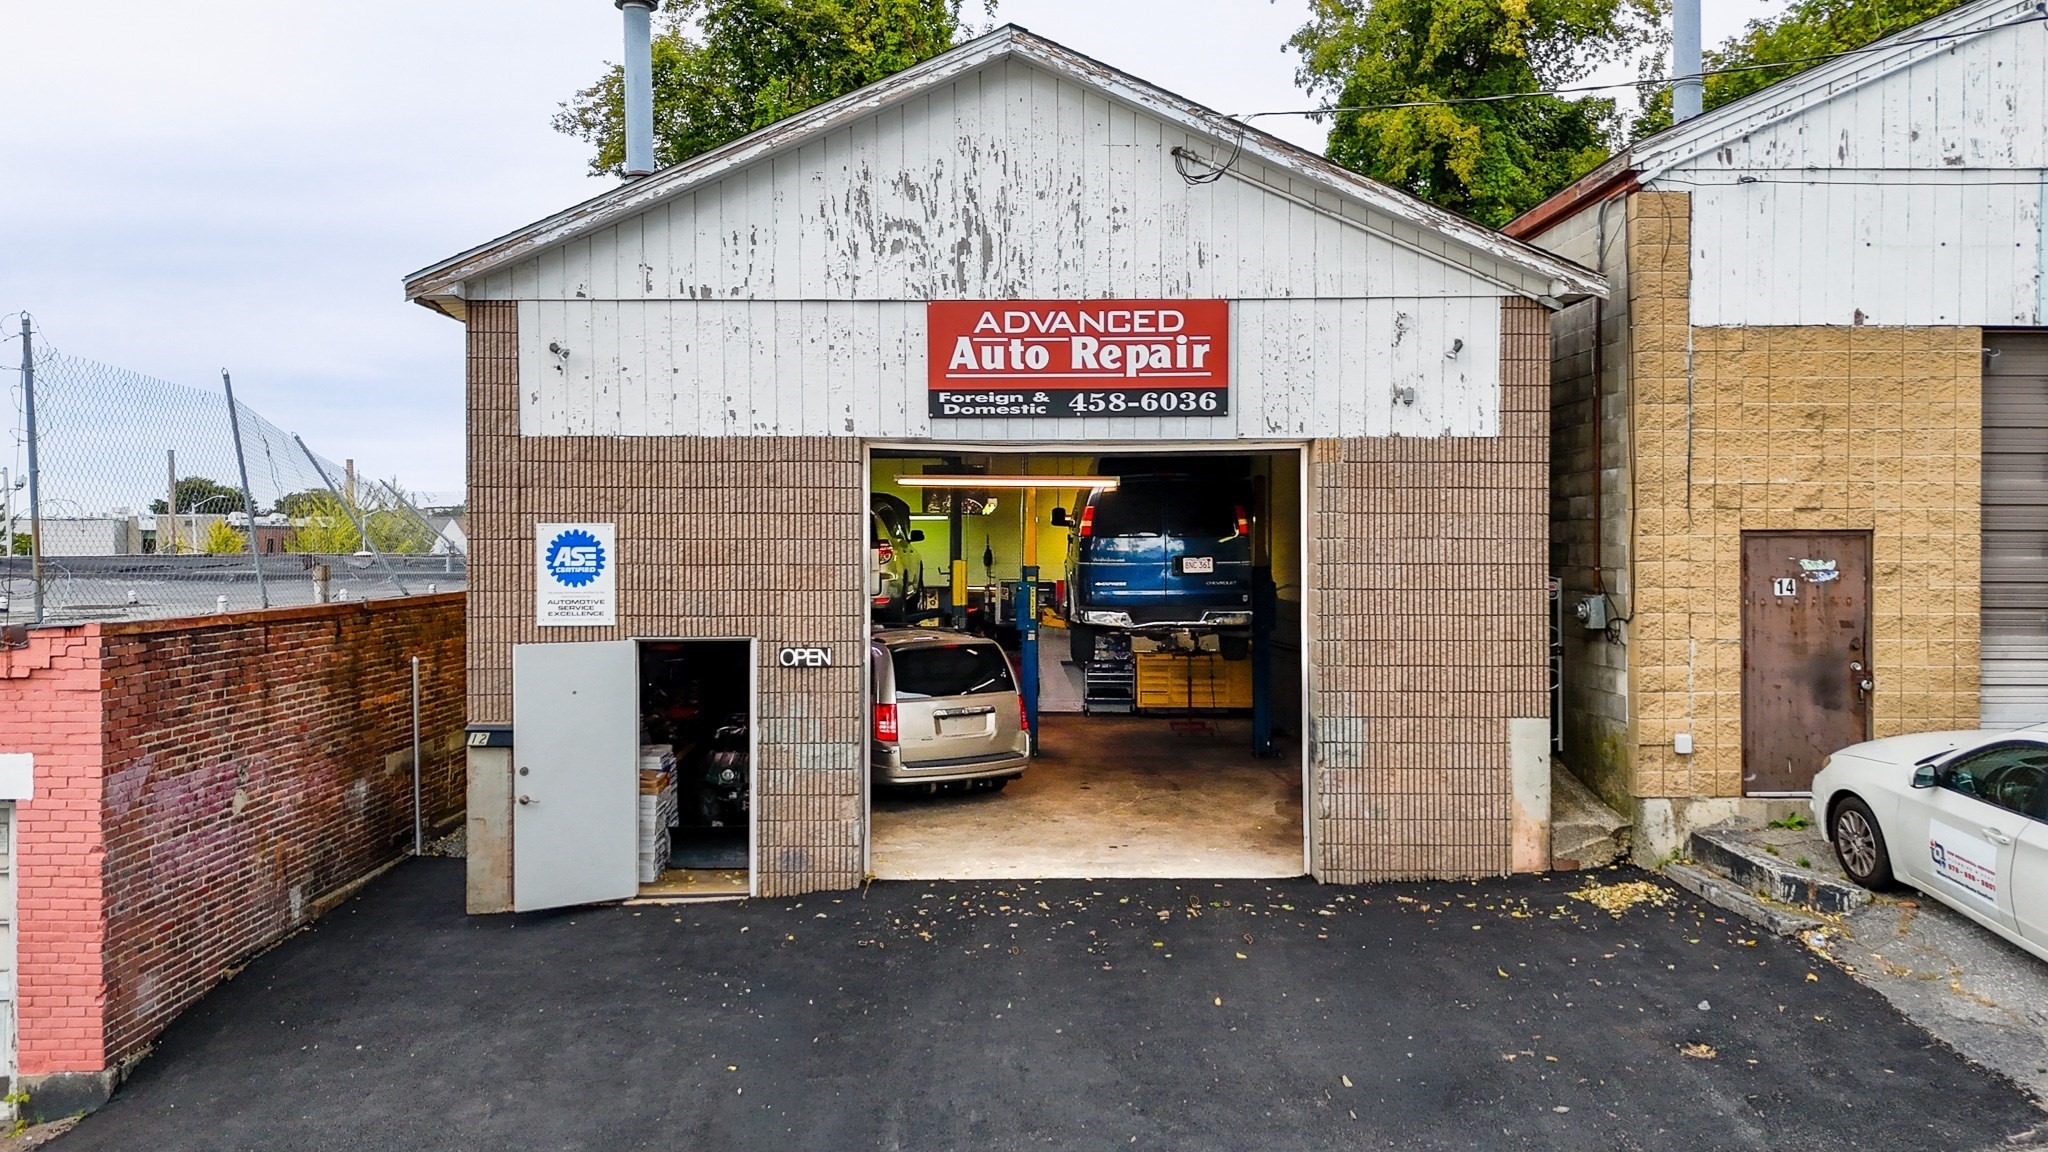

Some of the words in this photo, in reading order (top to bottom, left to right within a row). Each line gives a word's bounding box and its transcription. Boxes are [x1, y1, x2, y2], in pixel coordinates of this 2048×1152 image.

[973, 309, 1185, 334] ADVANCED
[949, 336, 1050, 370] Auto
[1071, 335, 1211, 378] Repair
[939, 392, 1024, 404] Foreign
[1032, 391, 1050, 403] &
[1068, 391, 1218, 413] 458-6036
[943, 403, 1047, 415] Domestic
[552, 546, 597, 566] ASE
[1777, 579, 1794, 594] 14
[780, 648, 831, 666] OPEN
[471, 733, 487, 745] 12
